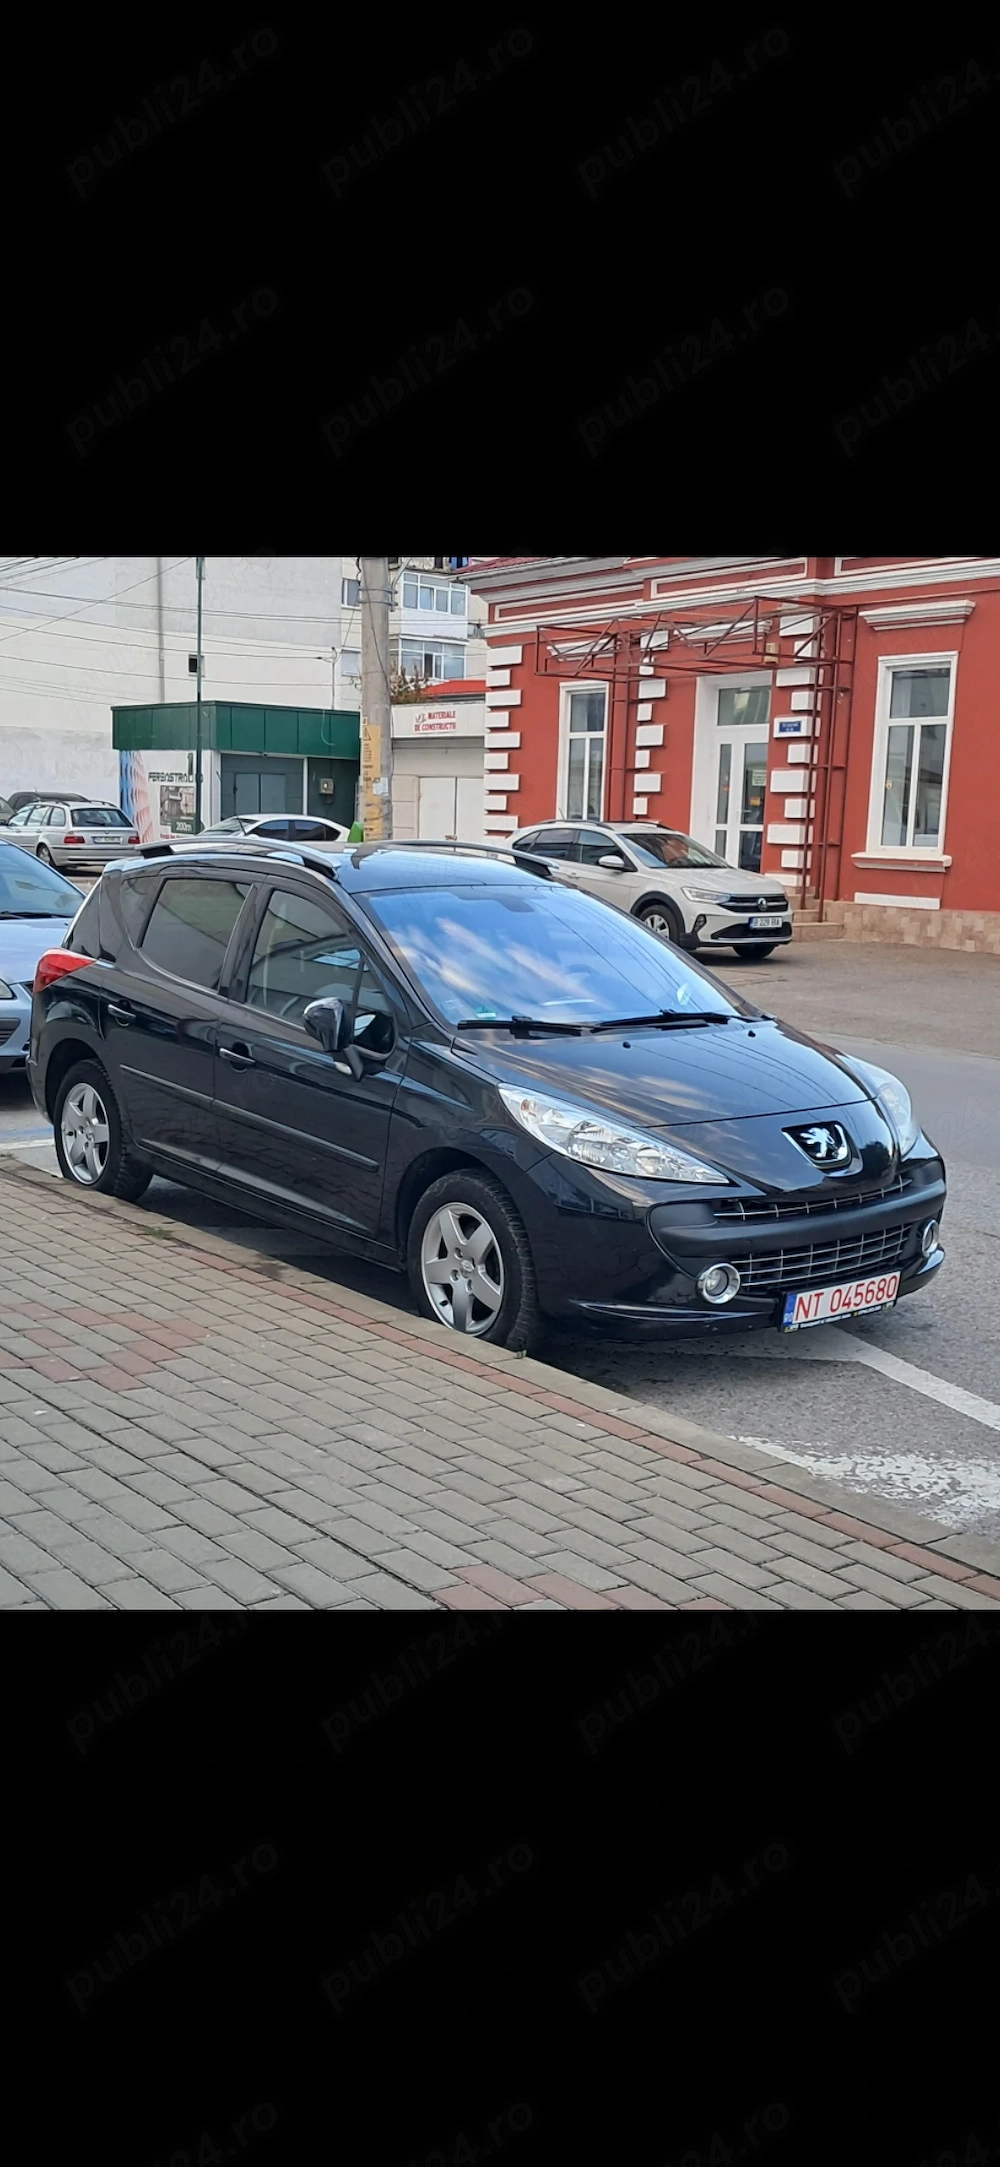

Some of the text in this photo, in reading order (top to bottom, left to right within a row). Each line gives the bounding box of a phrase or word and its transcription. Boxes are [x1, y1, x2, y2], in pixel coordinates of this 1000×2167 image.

[176, 821, 193, 833] 200m
[795, 1292, 824, 1321] NT
[829, 1275, 899, 1313] 045680
